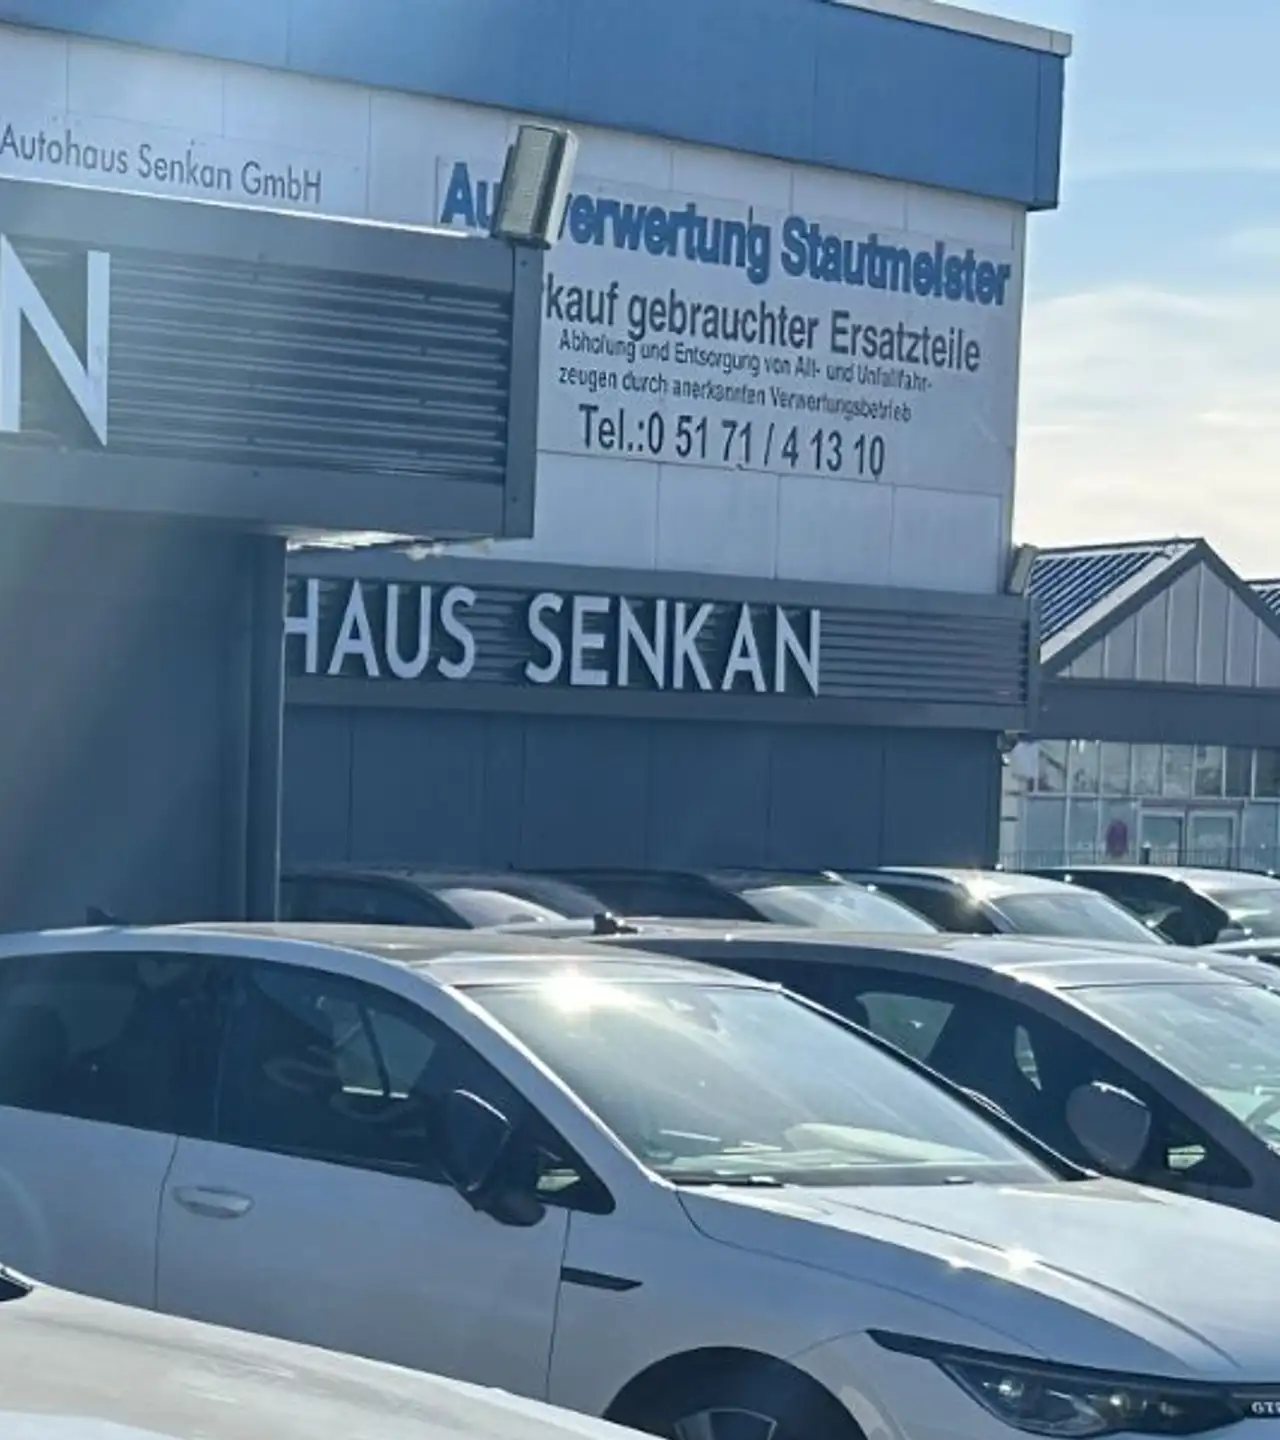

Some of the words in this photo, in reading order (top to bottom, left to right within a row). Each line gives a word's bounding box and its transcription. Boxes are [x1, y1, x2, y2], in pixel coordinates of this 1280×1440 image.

[137, 144, 232, 191] Senkan
[241, 160, 323, 204] GmbH
[440, 161, 771, 286] Auerwertung
[781, 215, 1012, 307] Stautmeister
[559, 328, 636, 363] Abholung
[641, 340, 670, 362] und
[674, 341, 760, 378] Entsorgung
[763, 356, 790, 376] von
[826, 363, 855, 383] und
[628, 288, 820, 350] gebrauchter
[830, 309, 981, 372] Ersatzteile
[559, 366, 618, 394] zeugen
[622, 371, 668, 394] durch
[675, 414, 708, 459] 51
[721, 419, 753, 464] 71
[781, 425, 800, 469] 4
[809, 427, 843, 472] 13
[854, 432, 886, 477] 10
[525, 591, 821, 697] SENKAN
